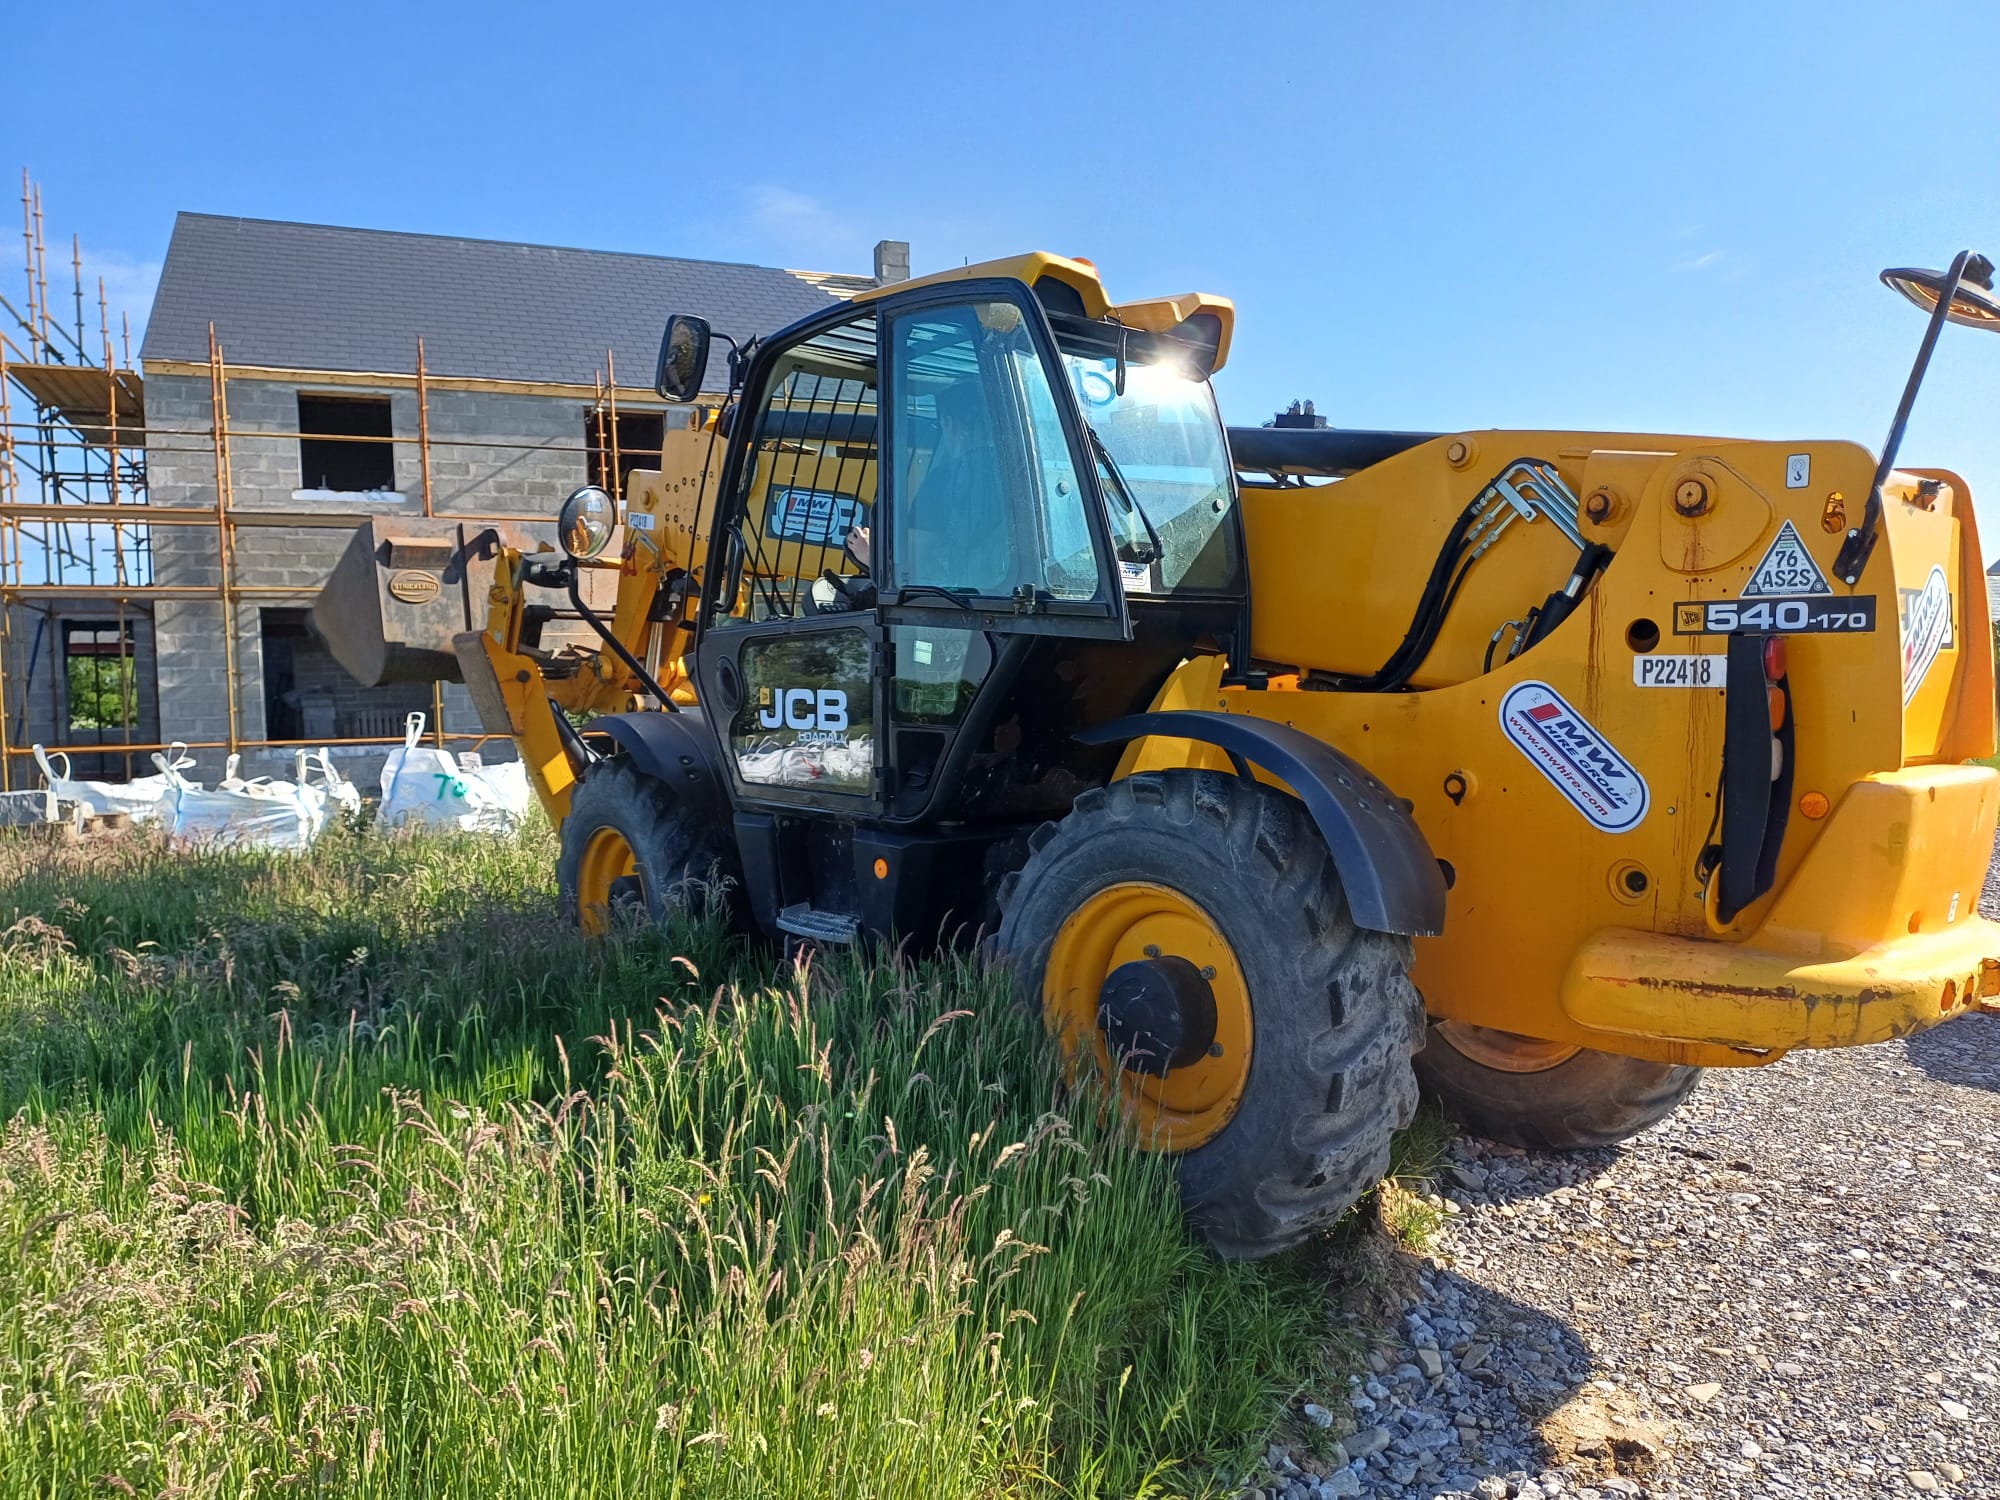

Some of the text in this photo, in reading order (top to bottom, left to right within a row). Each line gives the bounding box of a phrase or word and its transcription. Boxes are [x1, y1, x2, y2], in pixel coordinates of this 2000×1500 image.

[1762, 569, 1811, 588] AS2S
[1775, 550, 1798, 568] 76
[1642, 659, 1711, 685] P22418
[760, 688, 848, 731] JCB
[1509, 716, 1609, 816] www.mwhire.com
[1543, 725, 1629, 806] HIRE GROUP
[1555, 719, 1627, 779] MW
